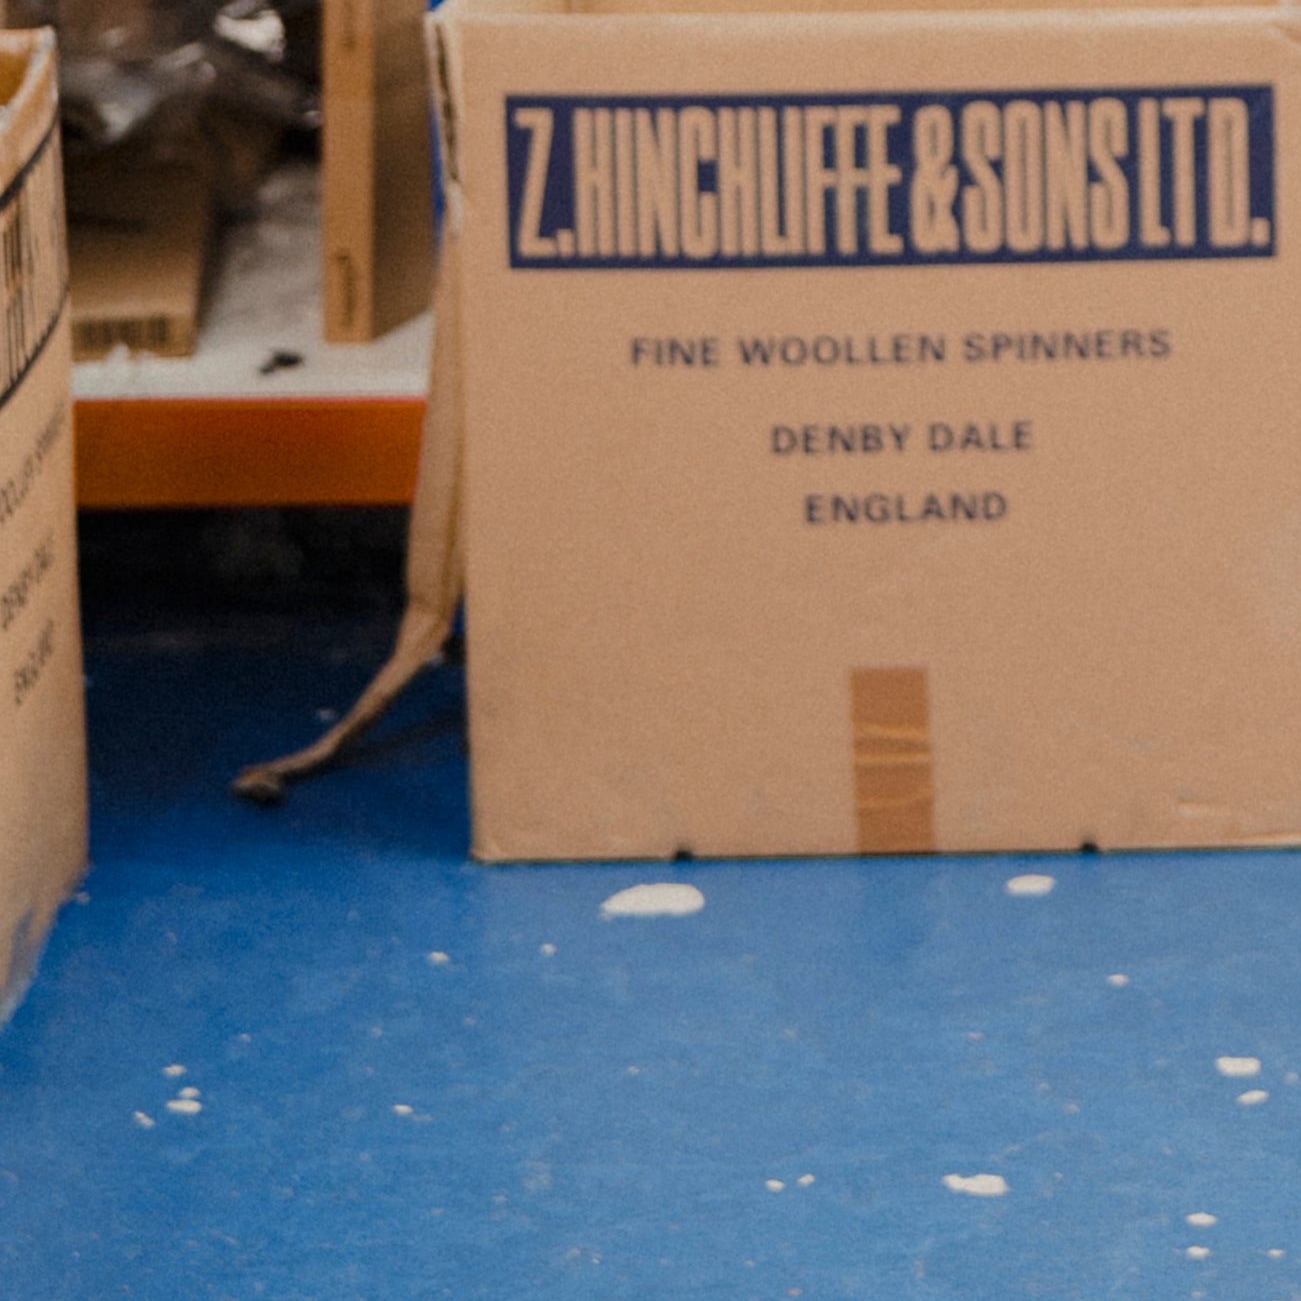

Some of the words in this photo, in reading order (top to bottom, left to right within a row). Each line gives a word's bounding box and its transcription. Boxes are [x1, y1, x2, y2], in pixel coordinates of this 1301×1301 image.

[1138, 96, 1270, 249] LTD.
[631, 335, 719, 368] FINE
[737, 333, 947, 367] WOOLLEN
[963, 328, 1173, 363] SPINNERS
[771, 423, 912, 455] DENBY
[928, 420, 1033, 452] DALE
[805, 491, 1008, 525] ENGLAND
